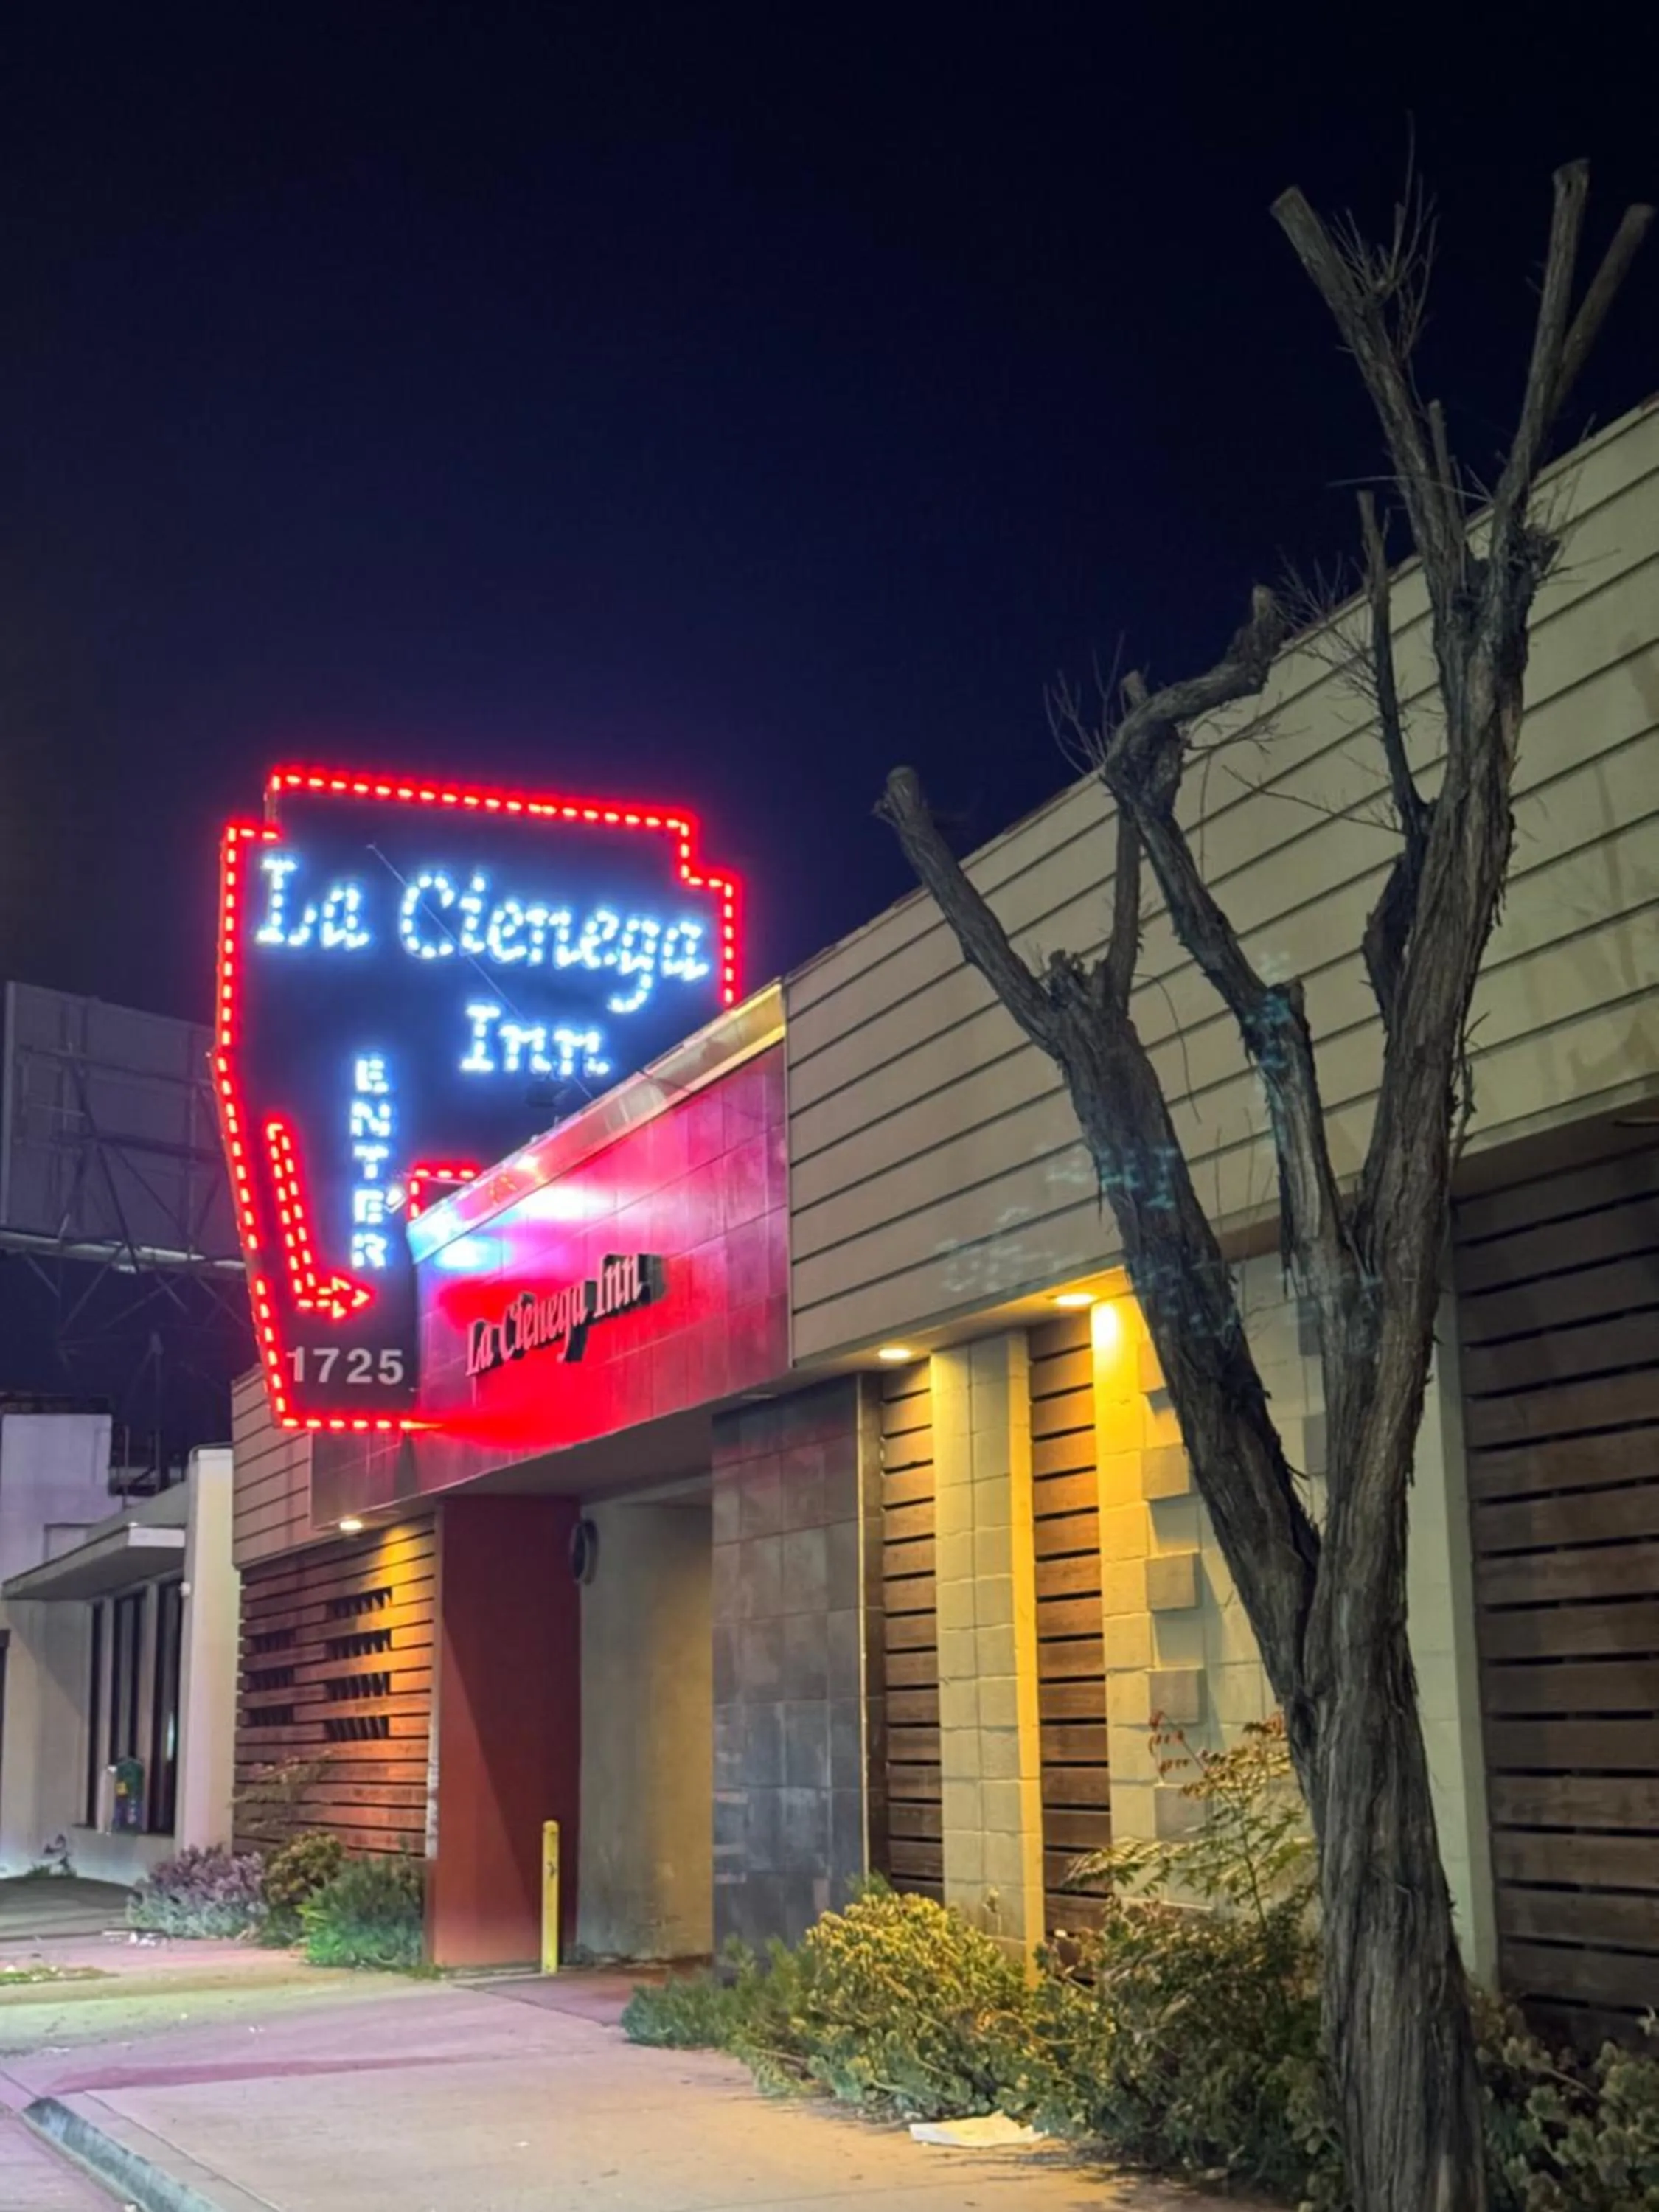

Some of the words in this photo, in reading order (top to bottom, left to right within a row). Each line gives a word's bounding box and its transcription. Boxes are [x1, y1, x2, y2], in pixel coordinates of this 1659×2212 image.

[255, 855, 369, 948] La
[400, 871, 711, 1015] Cienega
[458, 1002, 613, 1077] Inn
[350, 1057, 391, 1269] ENTER
[286, 1346, 405, 1384] 1725
[465, 1319, 495, 1377] La
[498, 1294, 588, 1363] Cienega
[593, 1253, 644, 1318] Inn
